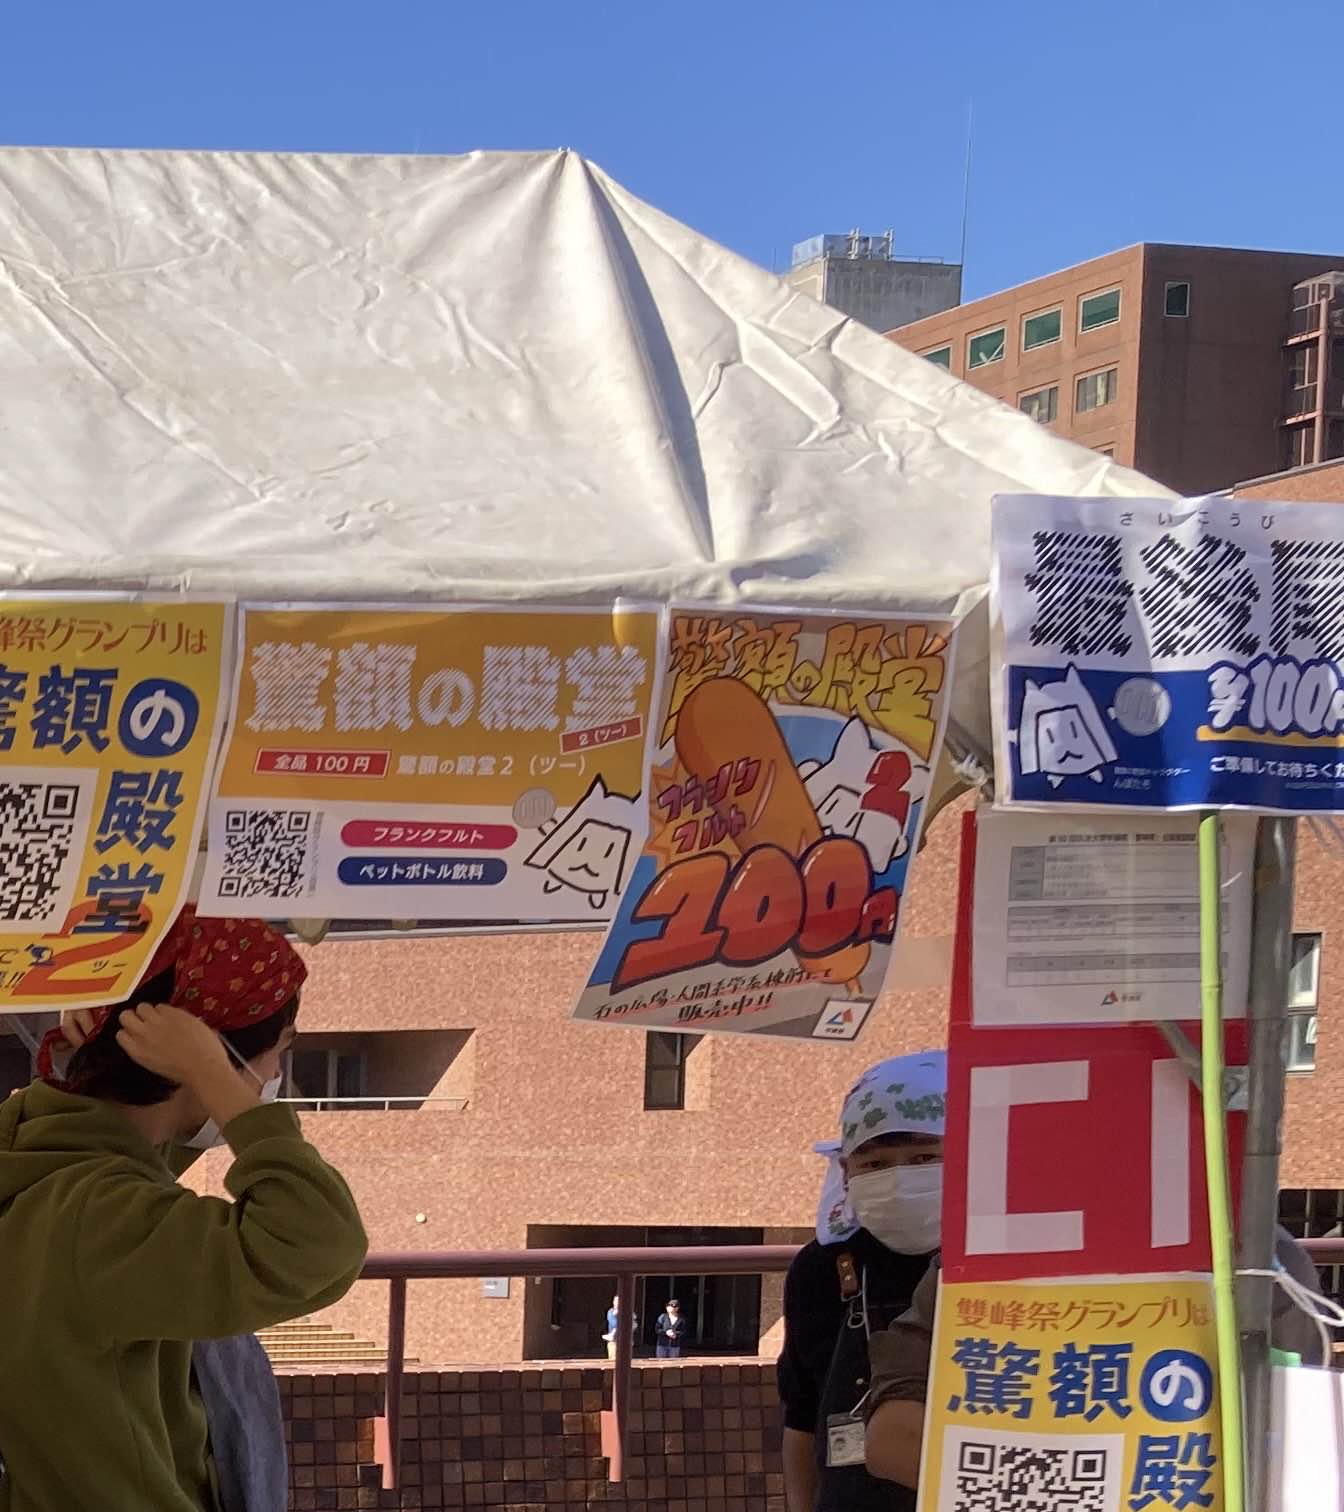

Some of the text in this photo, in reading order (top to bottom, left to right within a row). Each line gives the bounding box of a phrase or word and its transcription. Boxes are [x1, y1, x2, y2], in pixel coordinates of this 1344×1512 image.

[273, 755, 371, 773] 全品 100 円
[374, 827, 484, 843] フランクフルト
[672, 805, 747, 854] フルト
[360, 861, 483, 881] ペットボトル飲料
[957, 1295, 1208, 1333] 雙峰祭グランプリは
